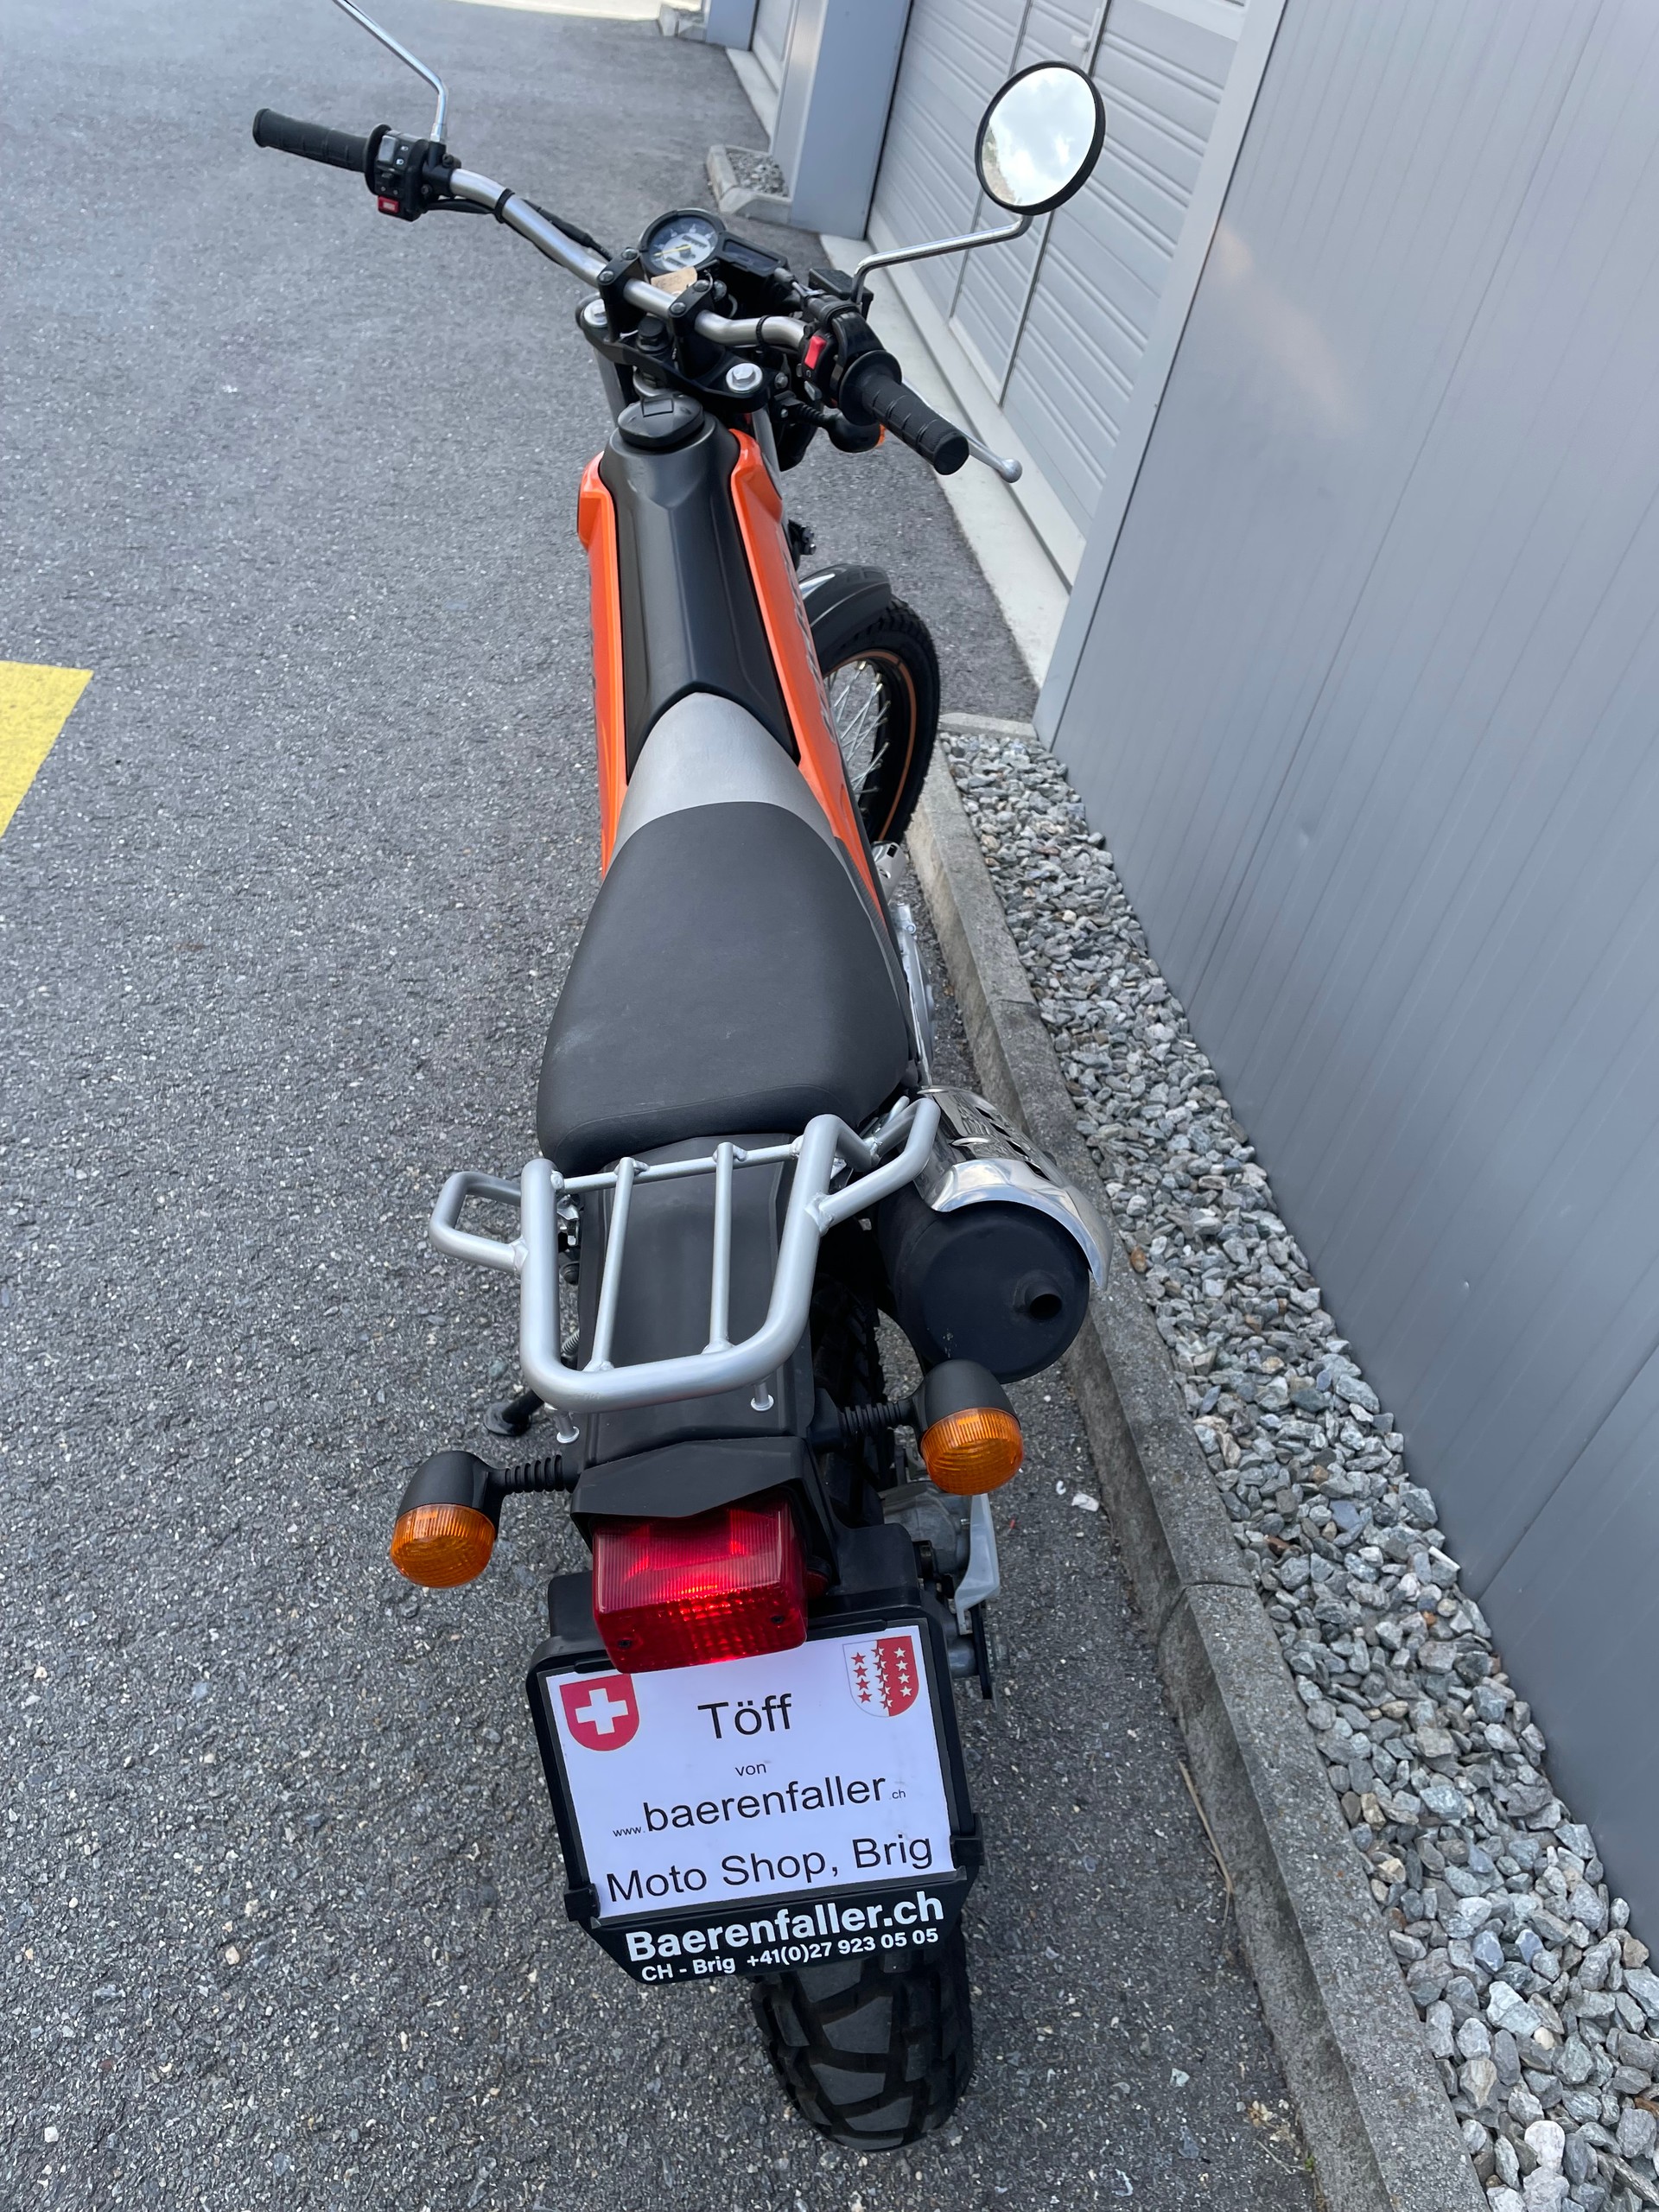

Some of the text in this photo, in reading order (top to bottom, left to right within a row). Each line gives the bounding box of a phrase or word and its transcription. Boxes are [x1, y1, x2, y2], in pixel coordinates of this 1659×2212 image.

[697, 1694, 791, 1739] Töff
[735, 1764, 767, 1777] von
[607, 1834, 932, 1903] Moto Shop, Brig
[625, 1891, 944, 1962] Baerenfaller.ch
[641, 1963, 674, 1981] CH
[692, 1955, 736, 1974] Brig
[747, 1942, 832, 1966] +41(0)27
[837, 1936, 876, 1955] 923
[880, 1931, 907, 1948] 05
[912, 1928, 938, 1945] 05
